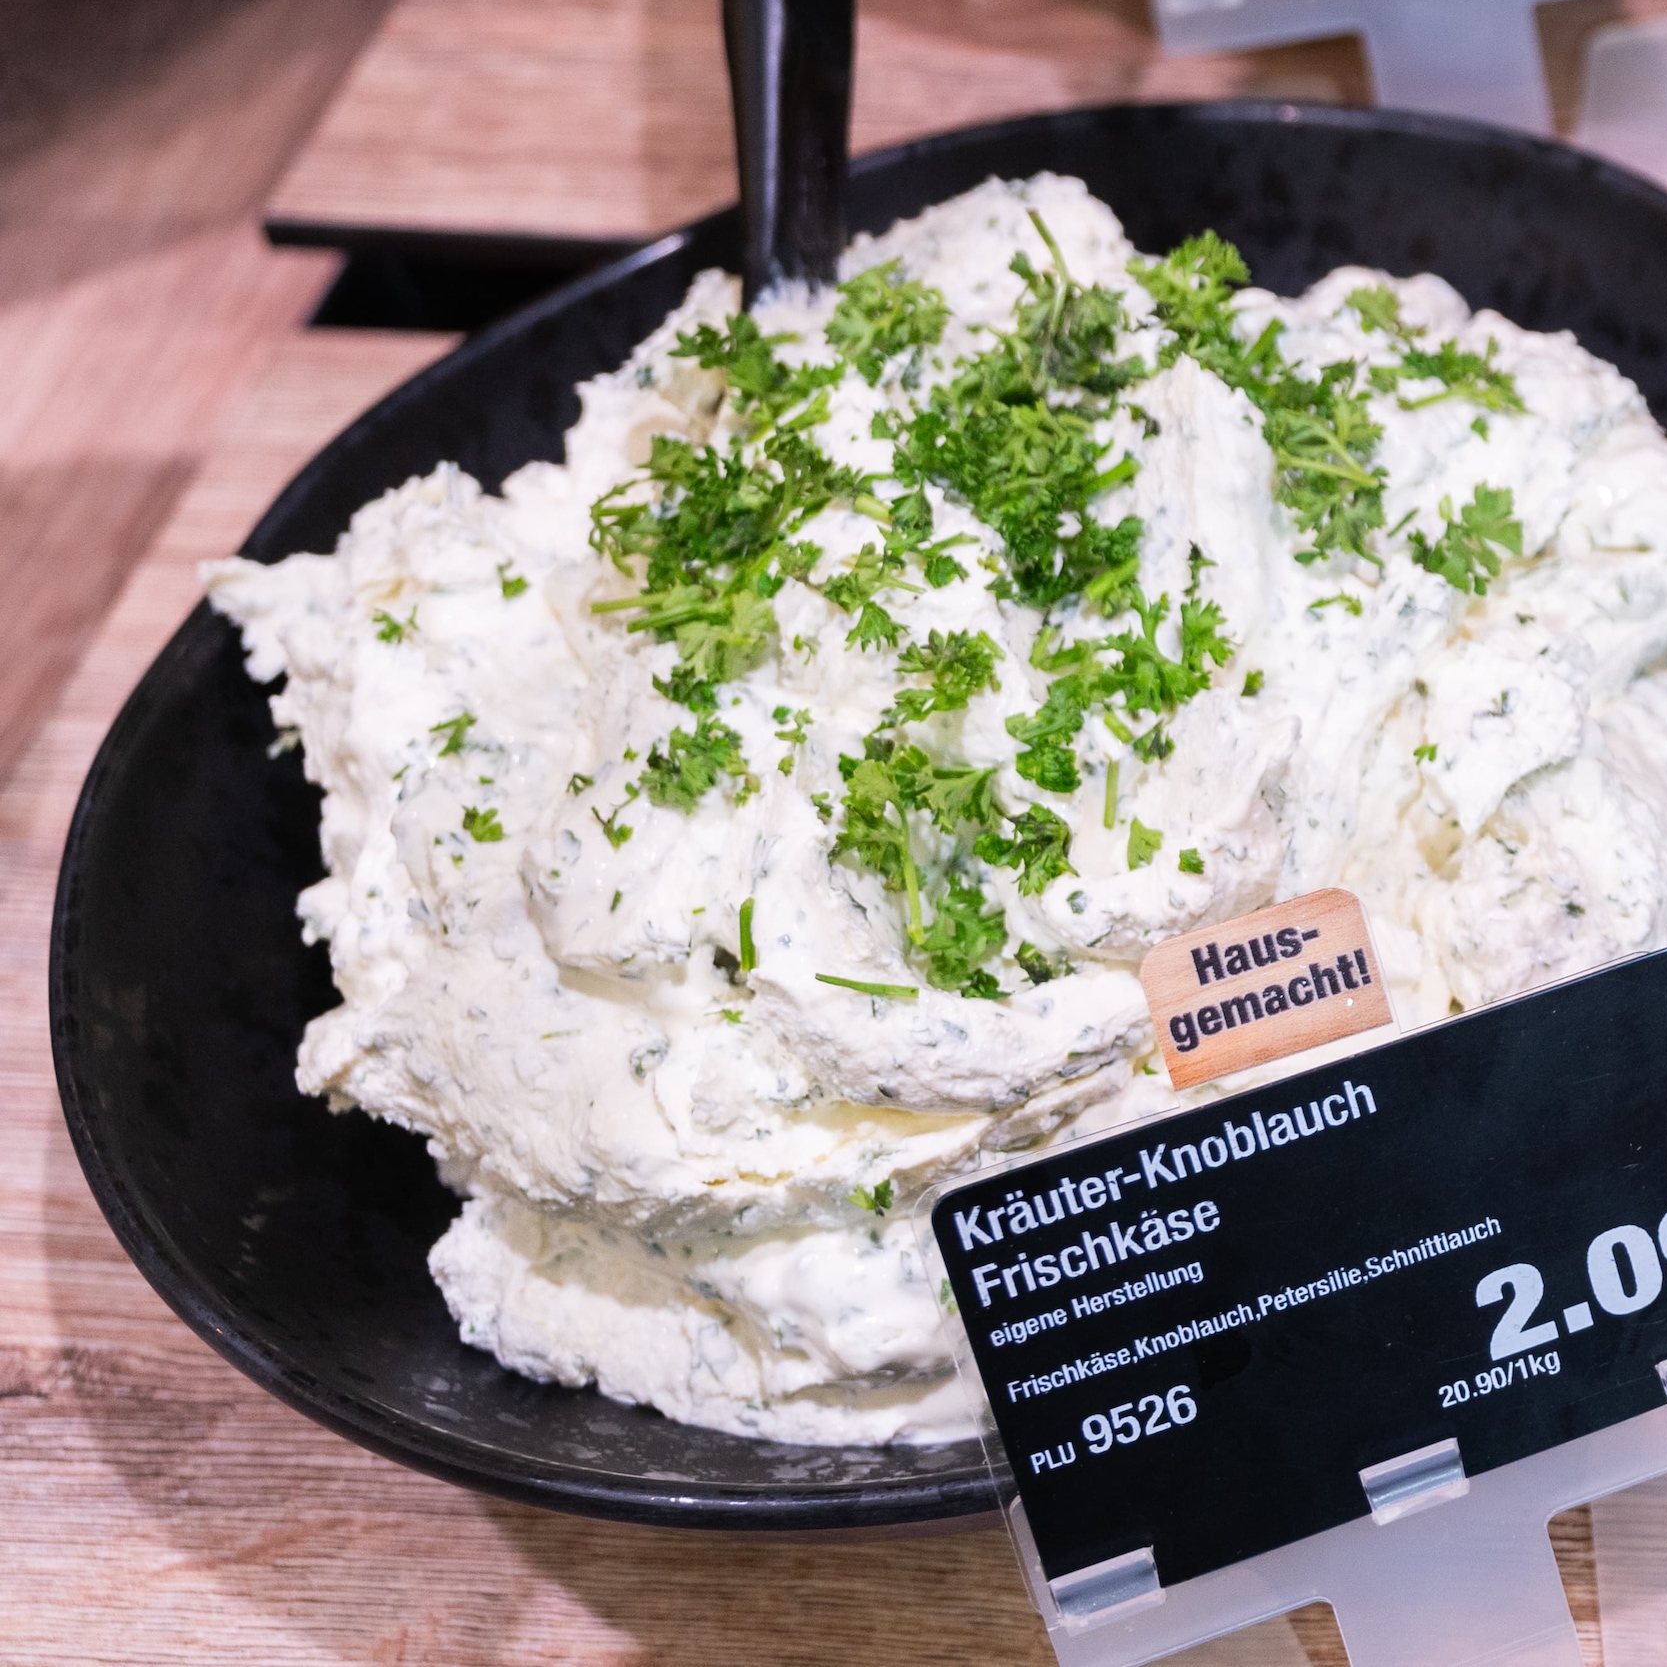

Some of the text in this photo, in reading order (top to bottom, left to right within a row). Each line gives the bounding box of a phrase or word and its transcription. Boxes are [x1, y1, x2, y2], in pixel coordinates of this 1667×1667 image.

[1169, 948, 1372, 1053] gemacht!
[1190, 926, 1321, 986] Haus-
[953, 1080, 1378, 1251] Kräuter-Knoblauch
[971, 1199, 1221, 1307] Frischkäse
[990, 1261, 1204, 1348] eigene Herstellung
[1438, 1350, 1561, 1408] 20.90/1kg
[1030, 1384, 1198, 1474] PLU 9526
